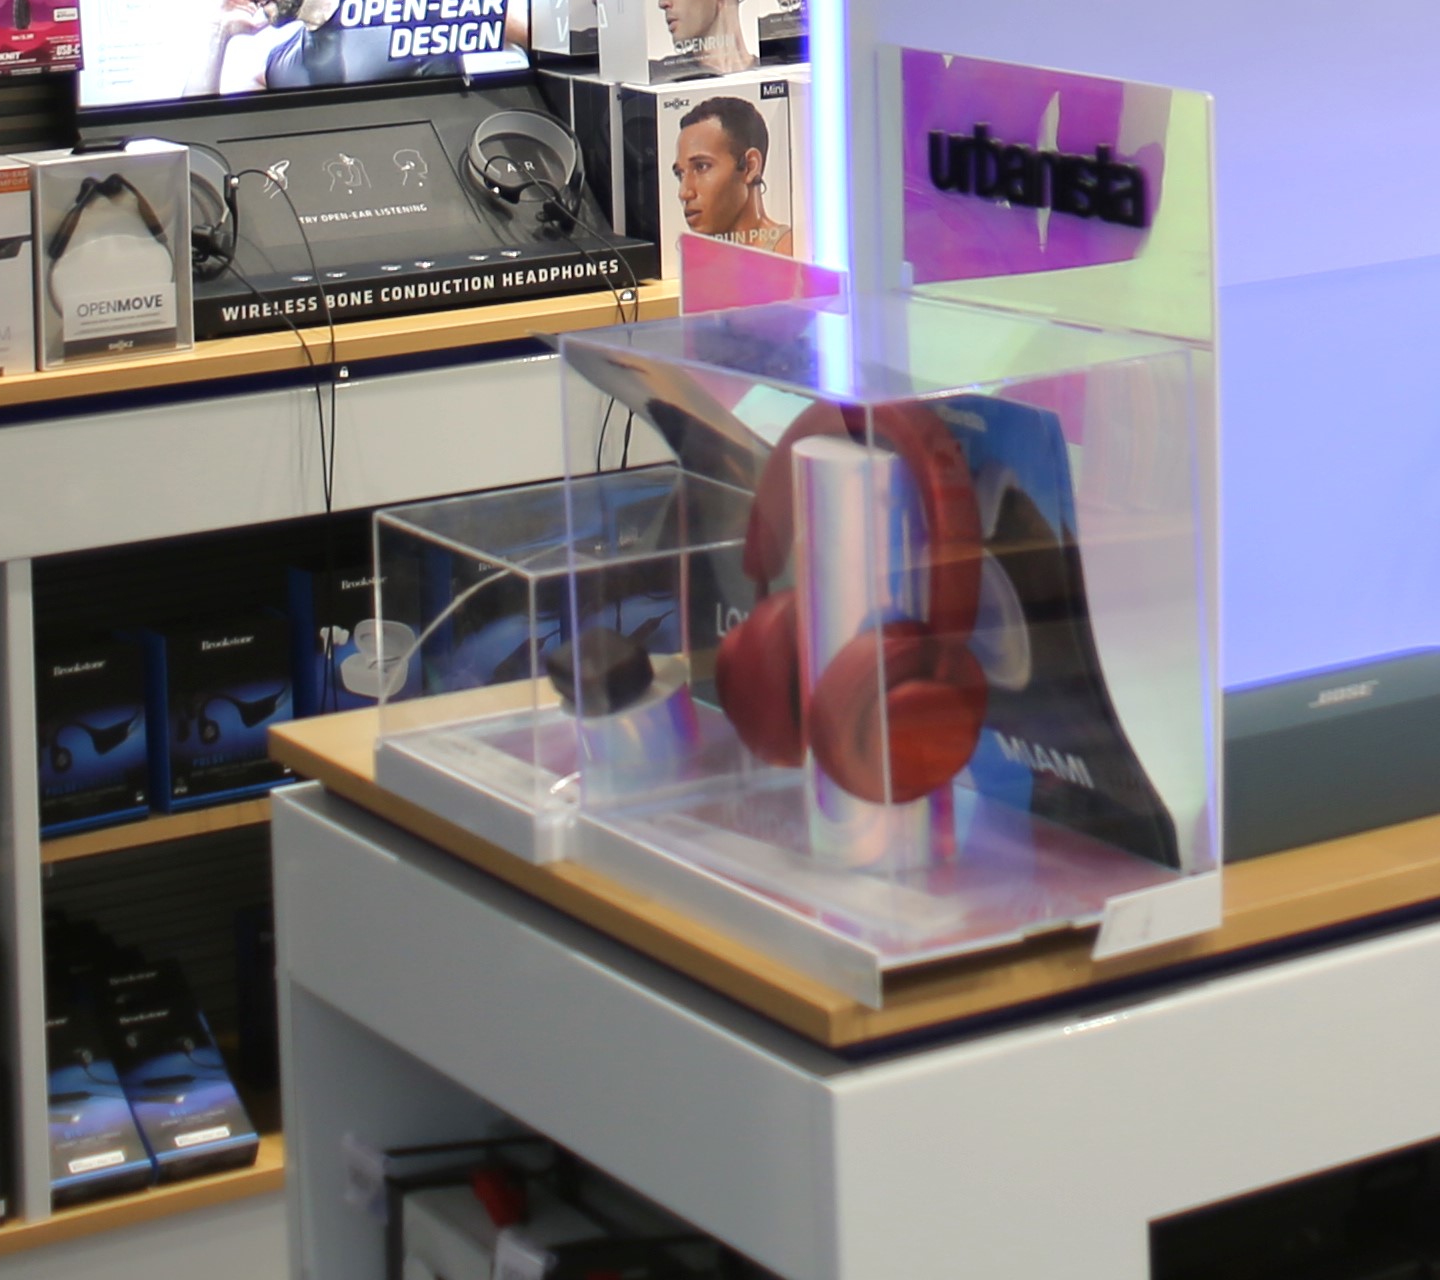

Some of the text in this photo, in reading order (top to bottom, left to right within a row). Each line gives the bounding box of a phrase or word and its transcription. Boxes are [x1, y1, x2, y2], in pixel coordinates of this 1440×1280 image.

[56, 44, 81, 56] USB-C
[389, 21, 502, 60] DESIGN
[763, 84, 784, 96] Mini
[927, 122, 1152, 229] urbanista
[321, 209, 373, 223] OPEN-EAR
[375, 203, 428, 217] LISTENING
[222, 259, 620, 321] WIRELESS BONE CONDUCTION HEADPHONES
[77, 294, 163, 318] OPENMOVE
